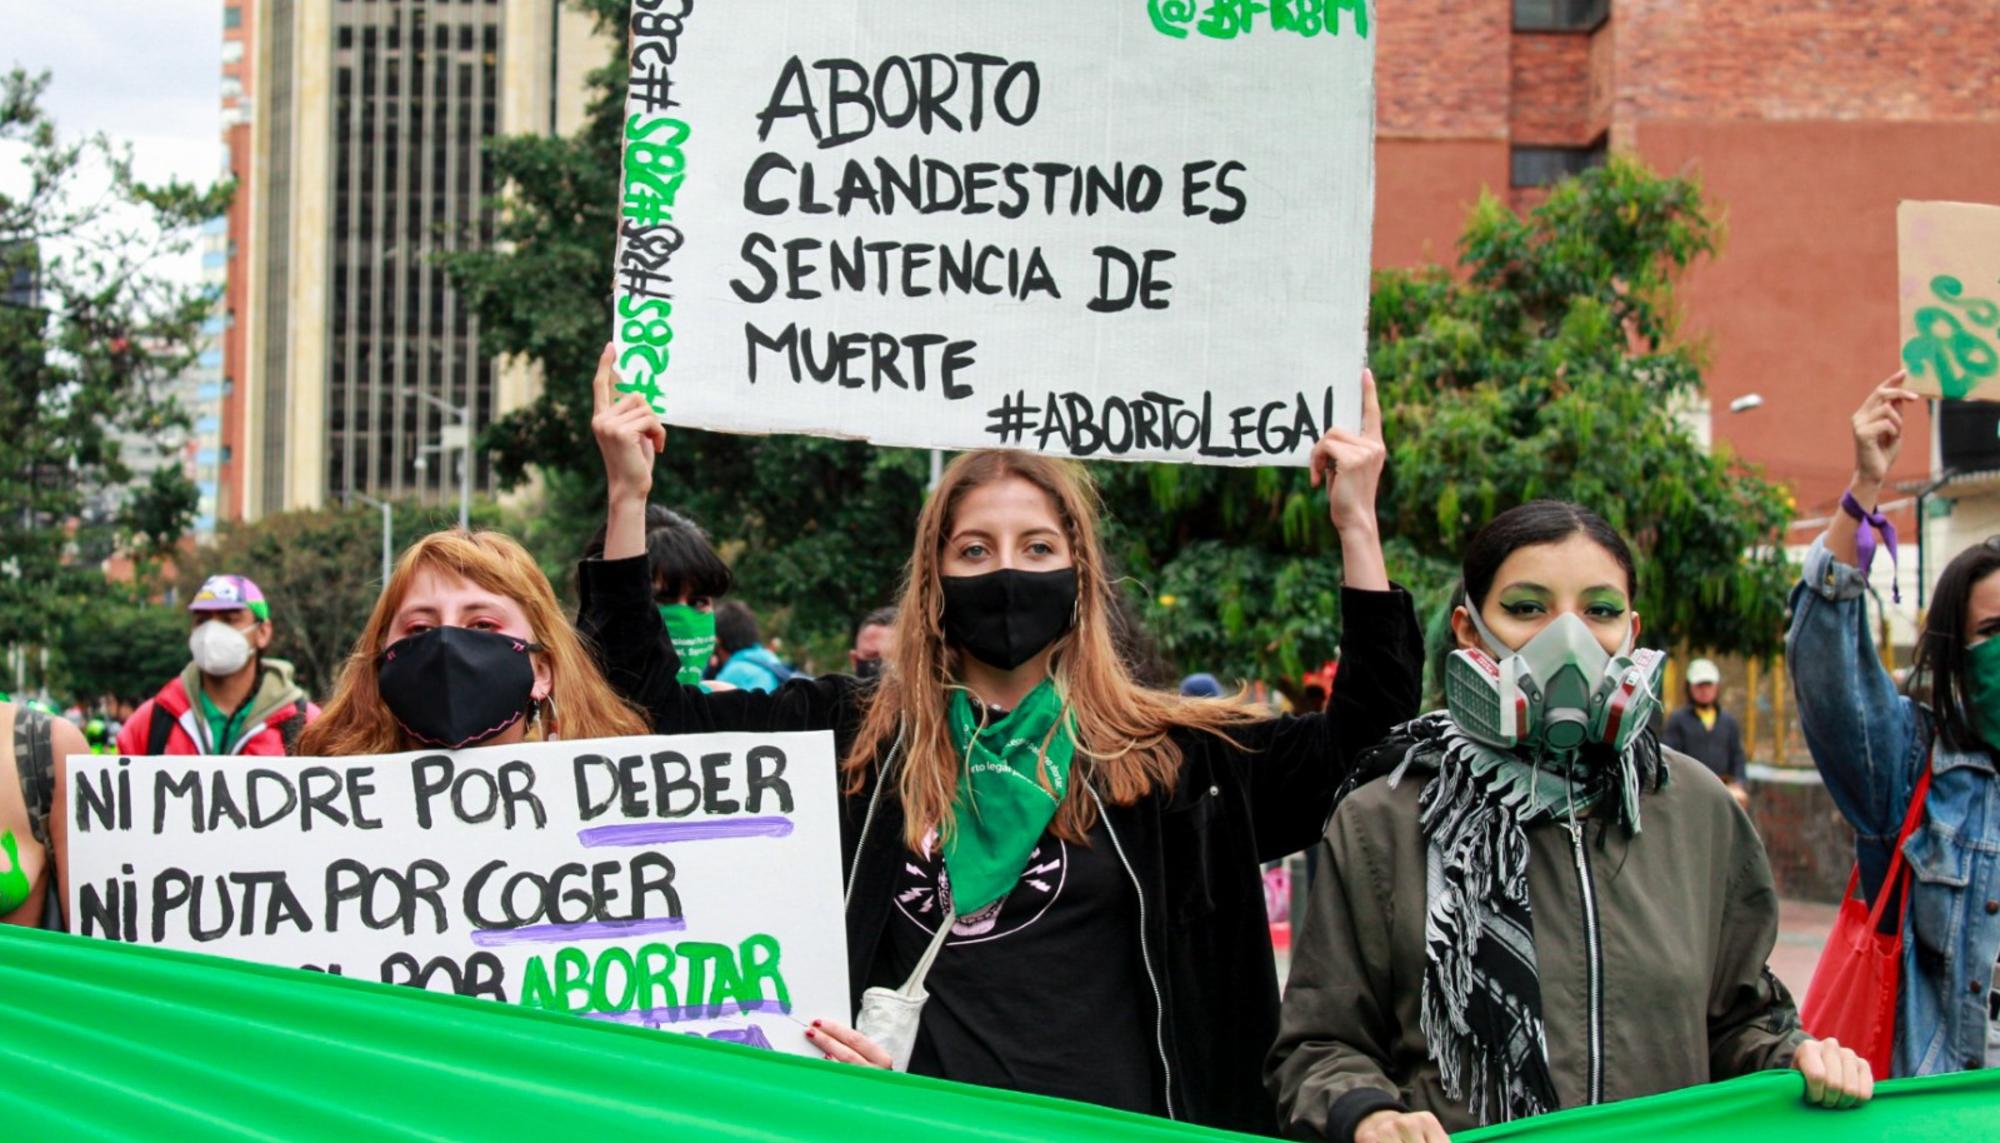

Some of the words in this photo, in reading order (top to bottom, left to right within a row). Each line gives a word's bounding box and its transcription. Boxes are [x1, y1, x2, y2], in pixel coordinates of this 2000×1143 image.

[755, 52, 1040, 149] ABORTO
[744, 152, 1163, 219] CLANDESTINO
[1182, 160, 1247, 224] ES
[729, 232, 1062, 303] SENTENCIA
[1086, 246, 1176, 313] DE
[745, 321, 977, 400] MUERTE
[153, 766, 383, 833] MADRE
[412, 755, 547, 829] POR
[573, 745, 794, 821] DEBER
[152, 867, 313, 942] PUTA
[325, 858, 450, 936] POR
[463, 851, 683, 930] COGER
[520, 933, 792, 1022] ABORTAR
